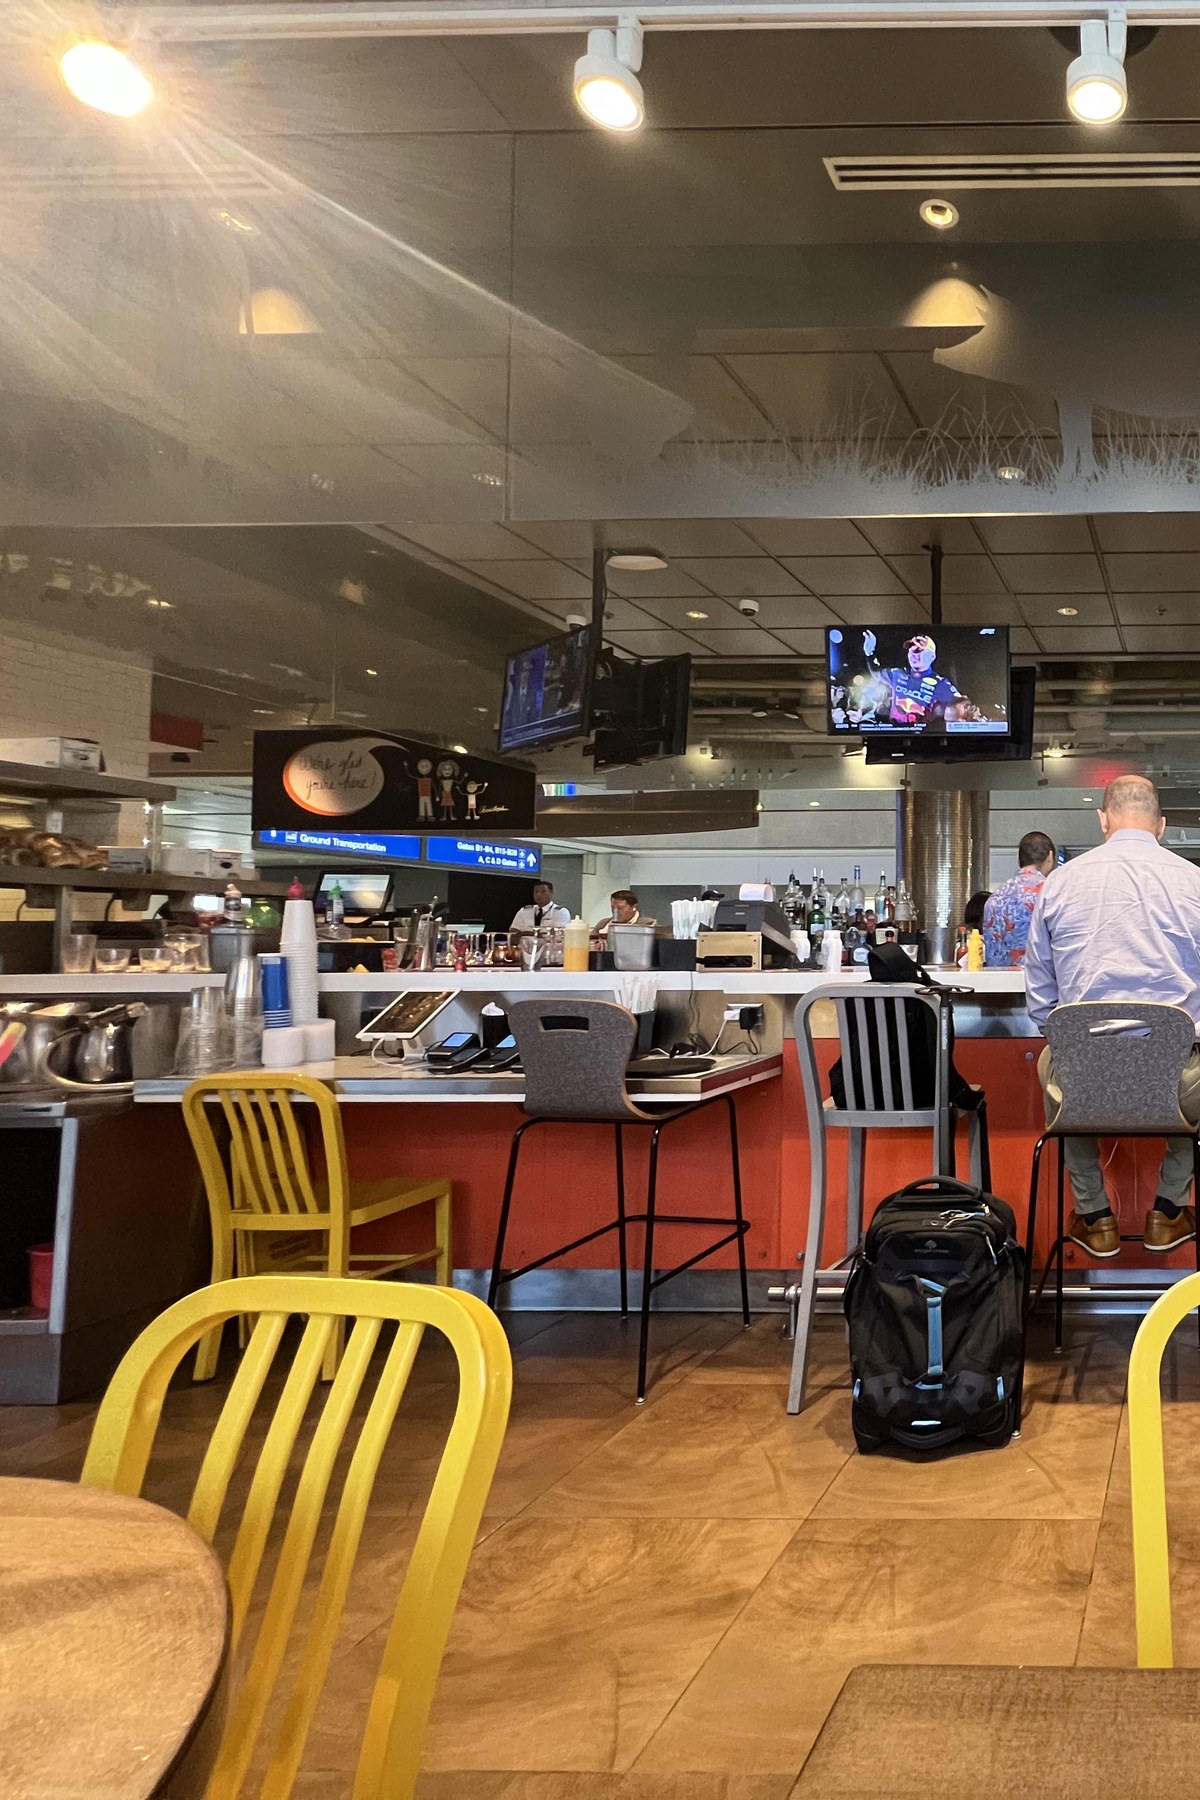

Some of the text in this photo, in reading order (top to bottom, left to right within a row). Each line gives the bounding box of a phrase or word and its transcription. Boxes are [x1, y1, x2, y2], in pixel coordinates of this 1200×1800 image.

[895, 685, 931, 703] ORACLE
[300, 834, 386, 852] Ground Transportation
[457, 842, 475, 851] Gates
